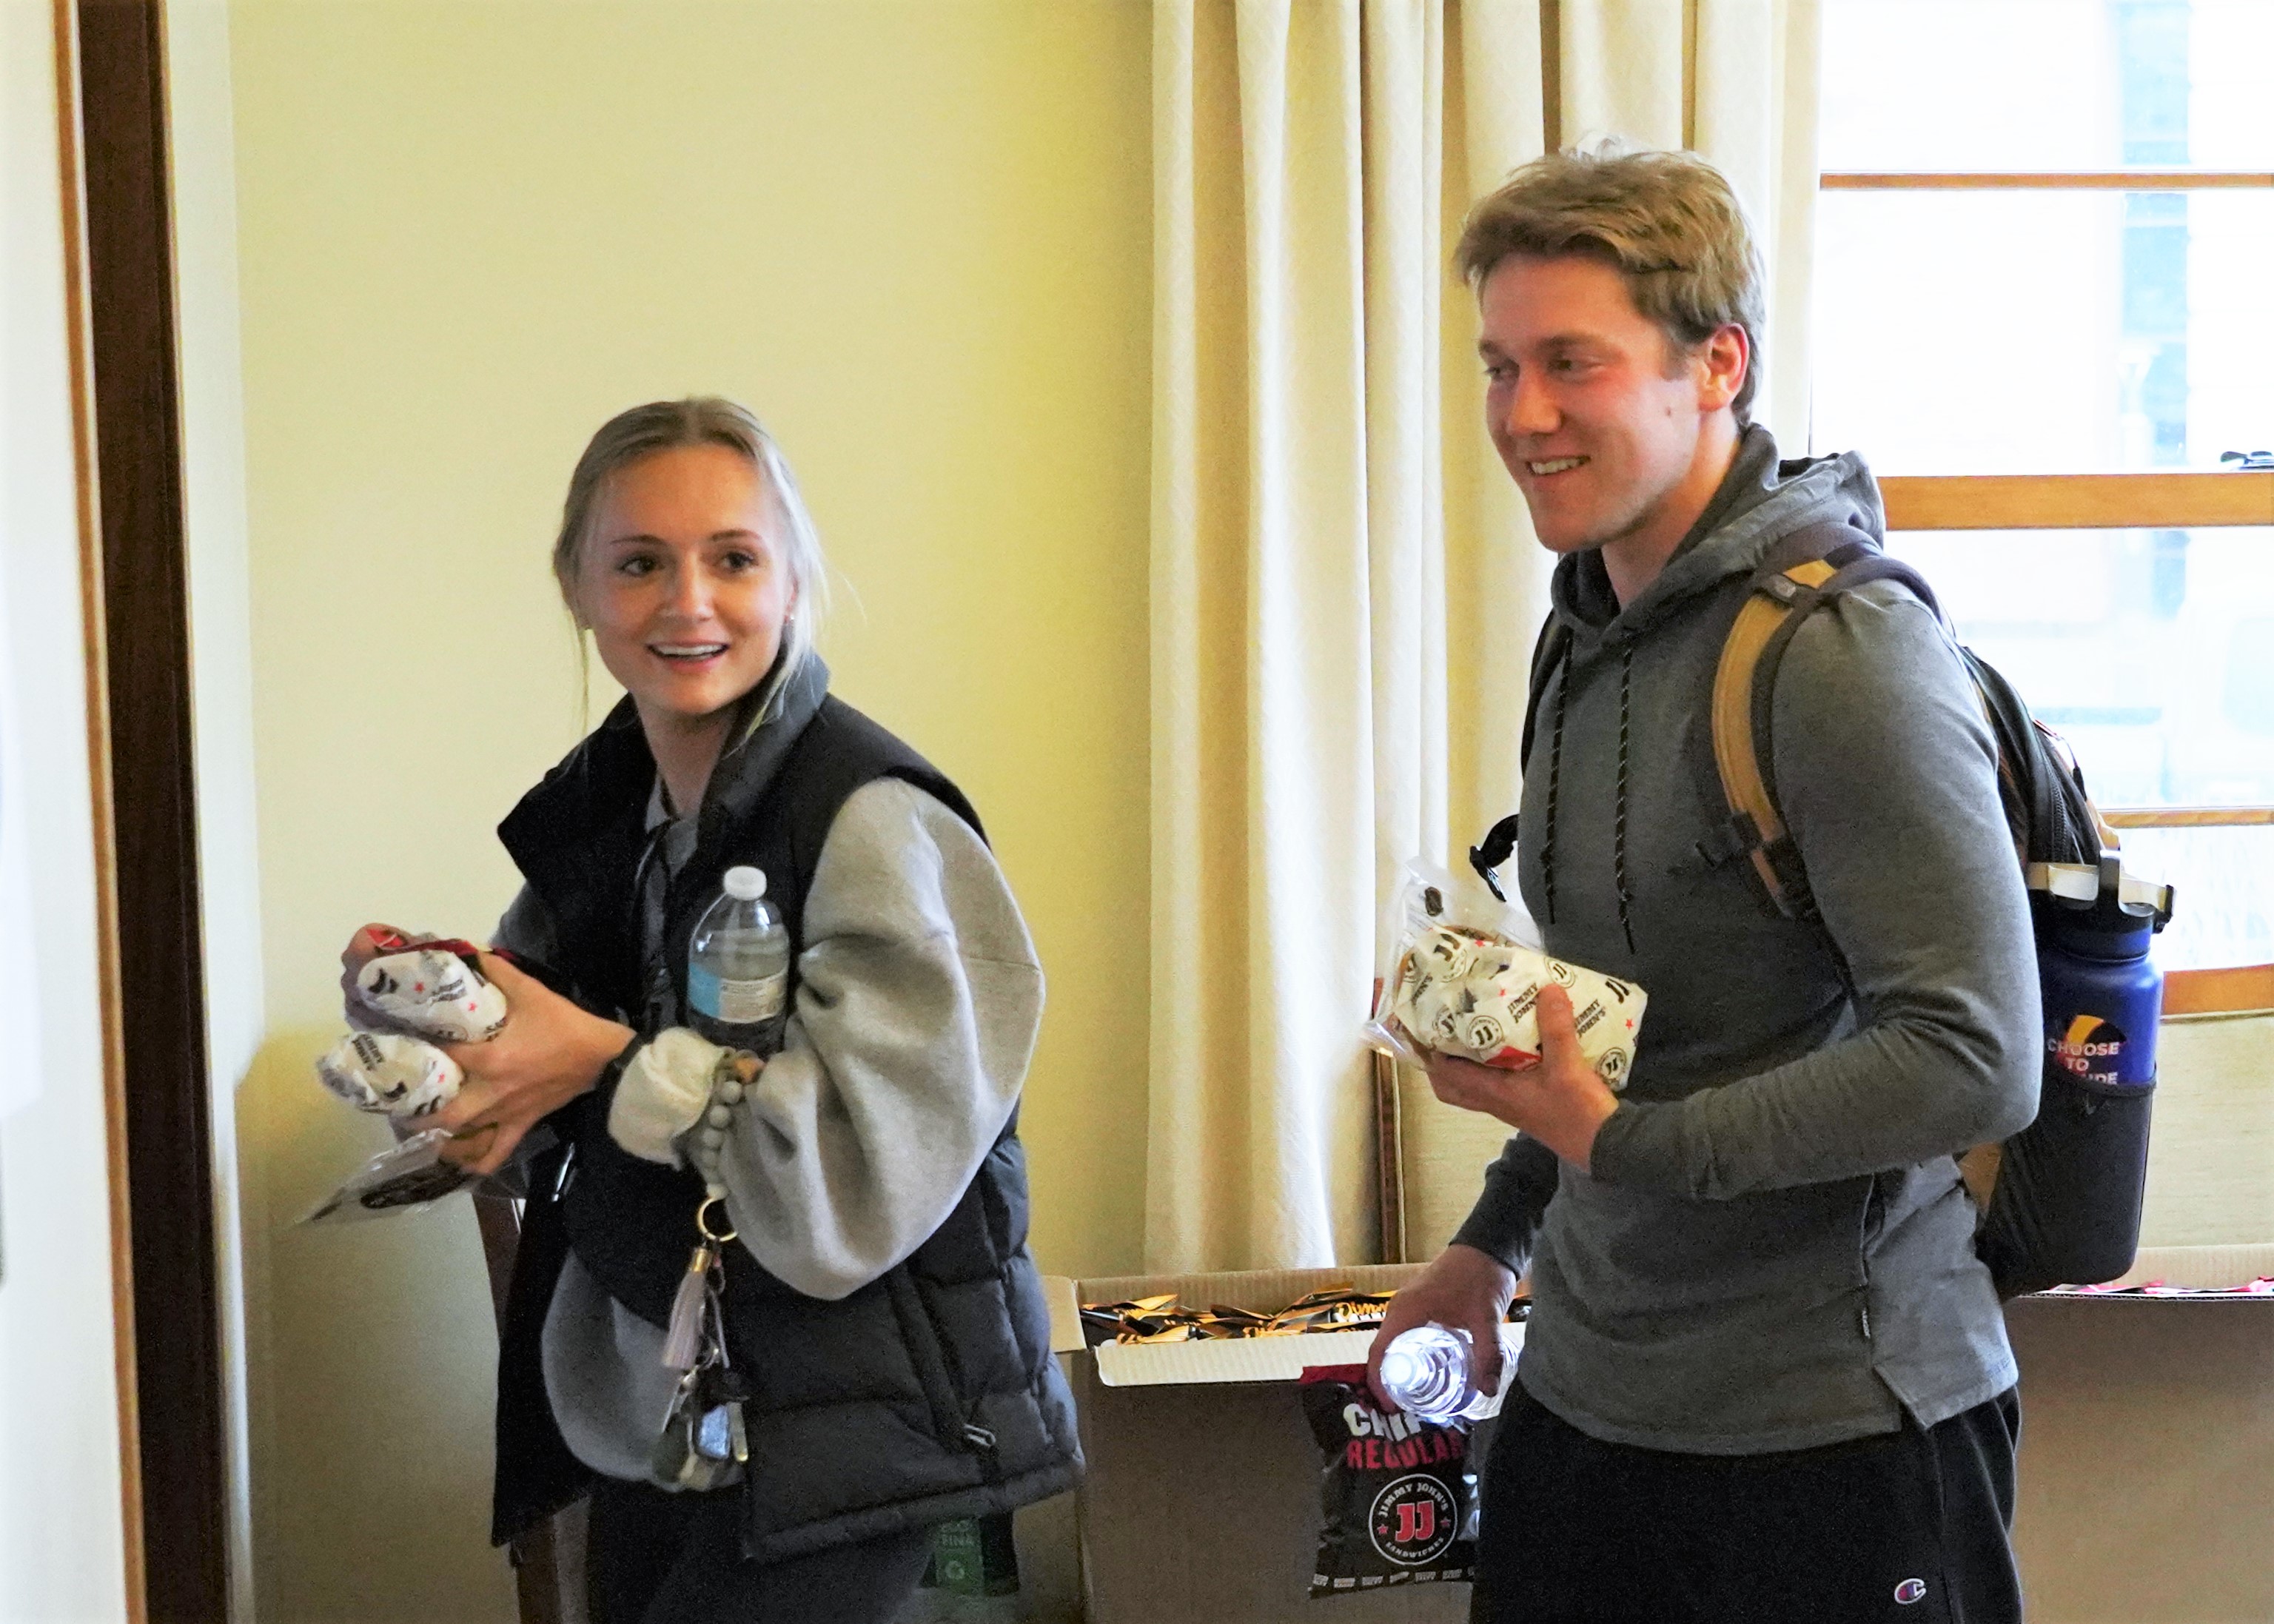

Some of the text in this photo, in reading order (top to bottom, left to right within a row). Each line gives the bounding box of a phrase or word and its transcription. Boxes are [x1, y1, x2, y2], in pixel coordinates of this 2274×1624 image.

[1507, 982, 1537, 1015] JIMMY
[2047, 1037, 2120, 1057] CHOOSE
[2065, 1057, 2090, 1072] TO
[1346, 1430, 1465, 1470] REGULAR
[1378, 1482, 1449, 1518] JIMMY JOHN'S
[1395, 1500, 1435, 1543] JJ
